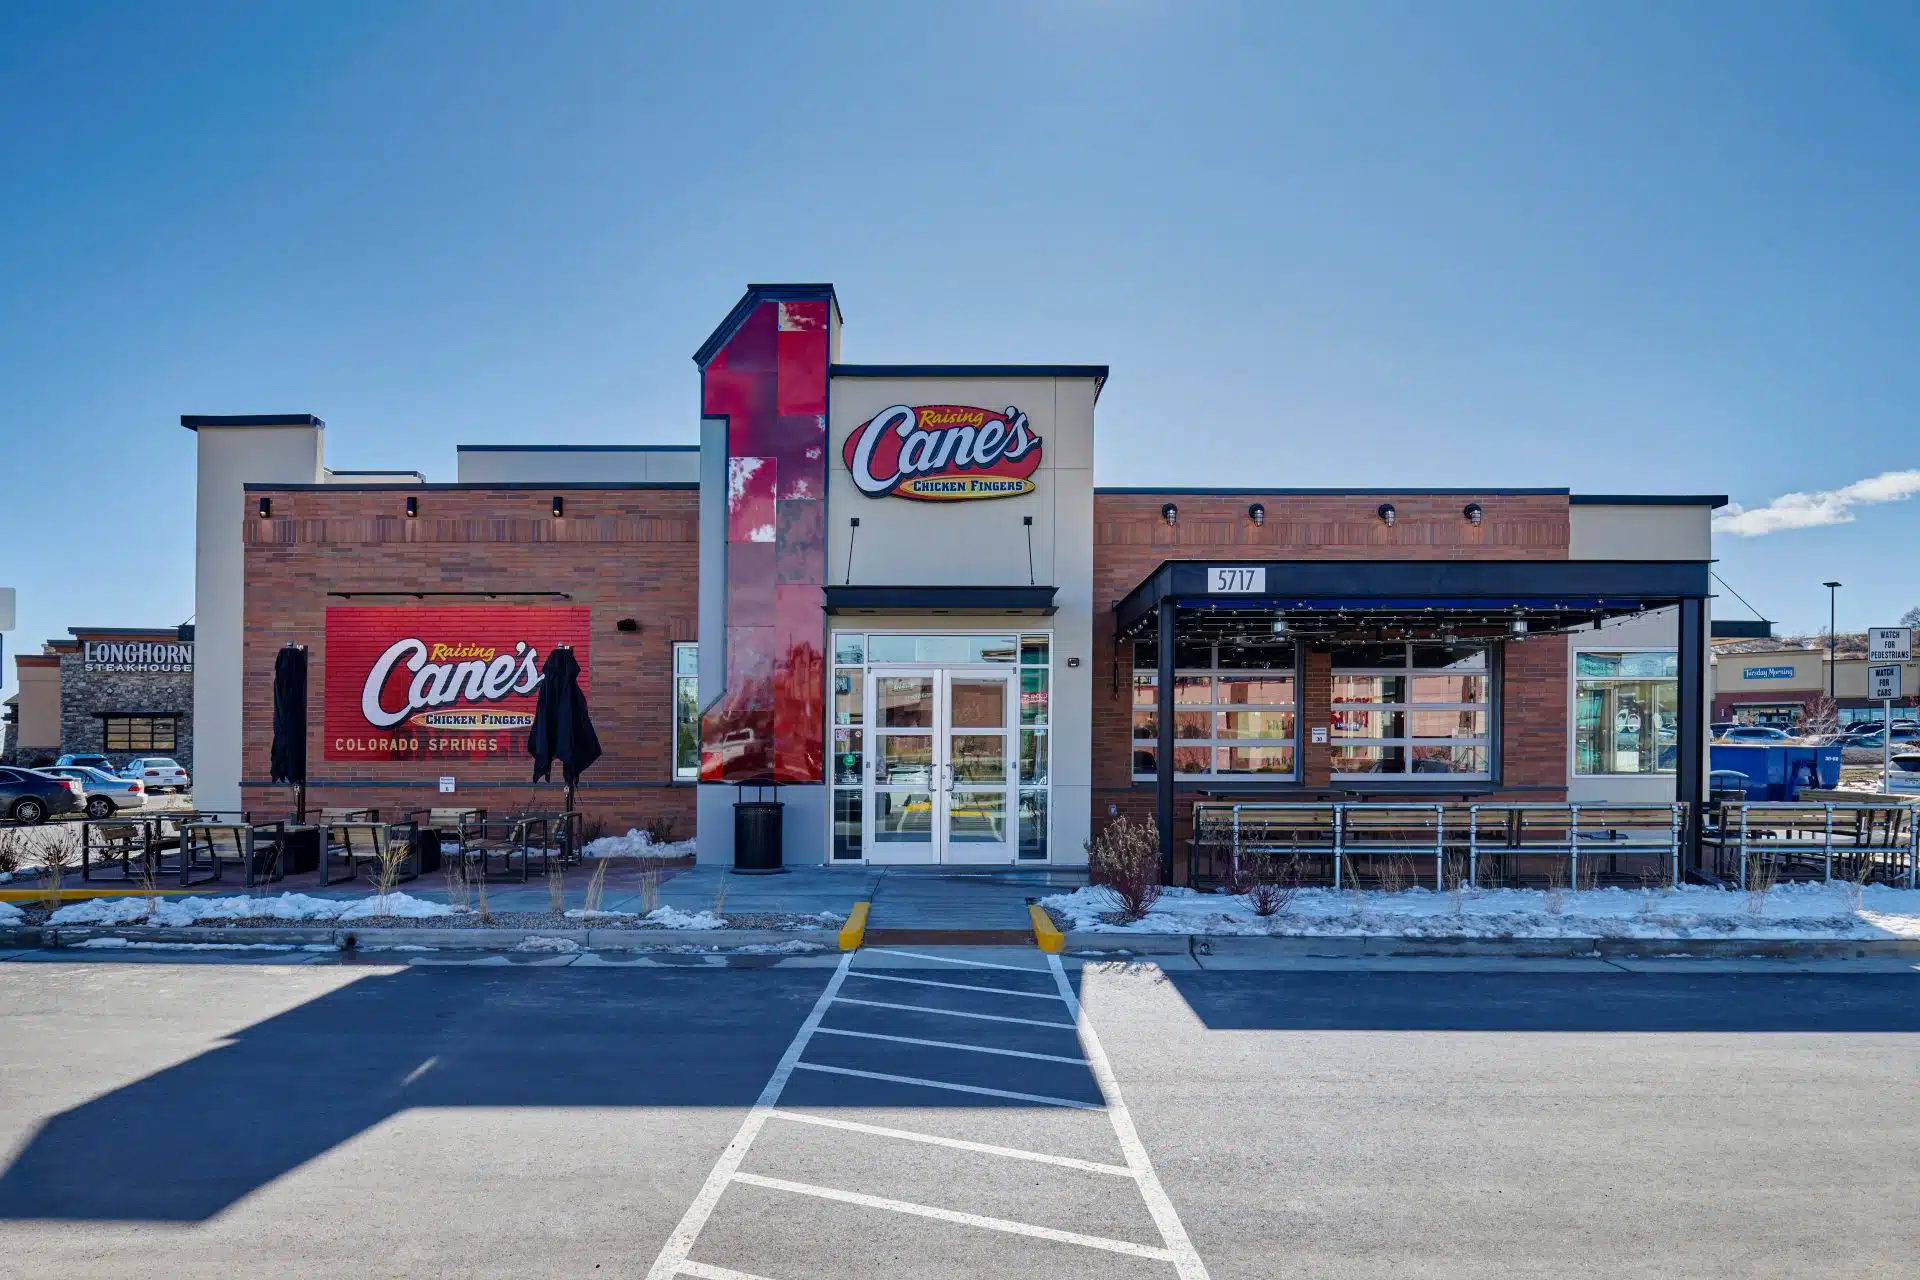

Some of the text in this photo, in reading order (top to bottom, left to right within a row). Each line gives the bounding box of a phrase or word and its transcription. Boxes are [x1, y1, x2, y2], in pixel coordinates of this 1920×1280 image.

[919, 409, 984, 428] Raising
[851, 404, 1040, 493] Cane's
[913, 479, 1023, 492] CHICKEN FINGERS
[1217, 569, 1256, 591] 5717
[1880, 630, 1900, 639] WATCH
[1884, 641, 1896, 649] FOR
[84, 642, 192, 664] LONGHORN
[430, 642, 497, 661] Raising
[1870, 651, 1910, 659] PEDESTRIANS
[84, 664, 192, 672] STEAKHOUSE
[1745, 668, 1768, 678] Tuesday
[1875, 669, 1894, 677] WATCH
[361, 638, 546, 727] Cane's
[1879, 678, 1890, 687] FOR
[1877, 689, 1892, 697] CARS
[425, 713, 532, 725] CHICKEN FINGERS
[335, 738, 498, 751] COLORADO SPRINGS
